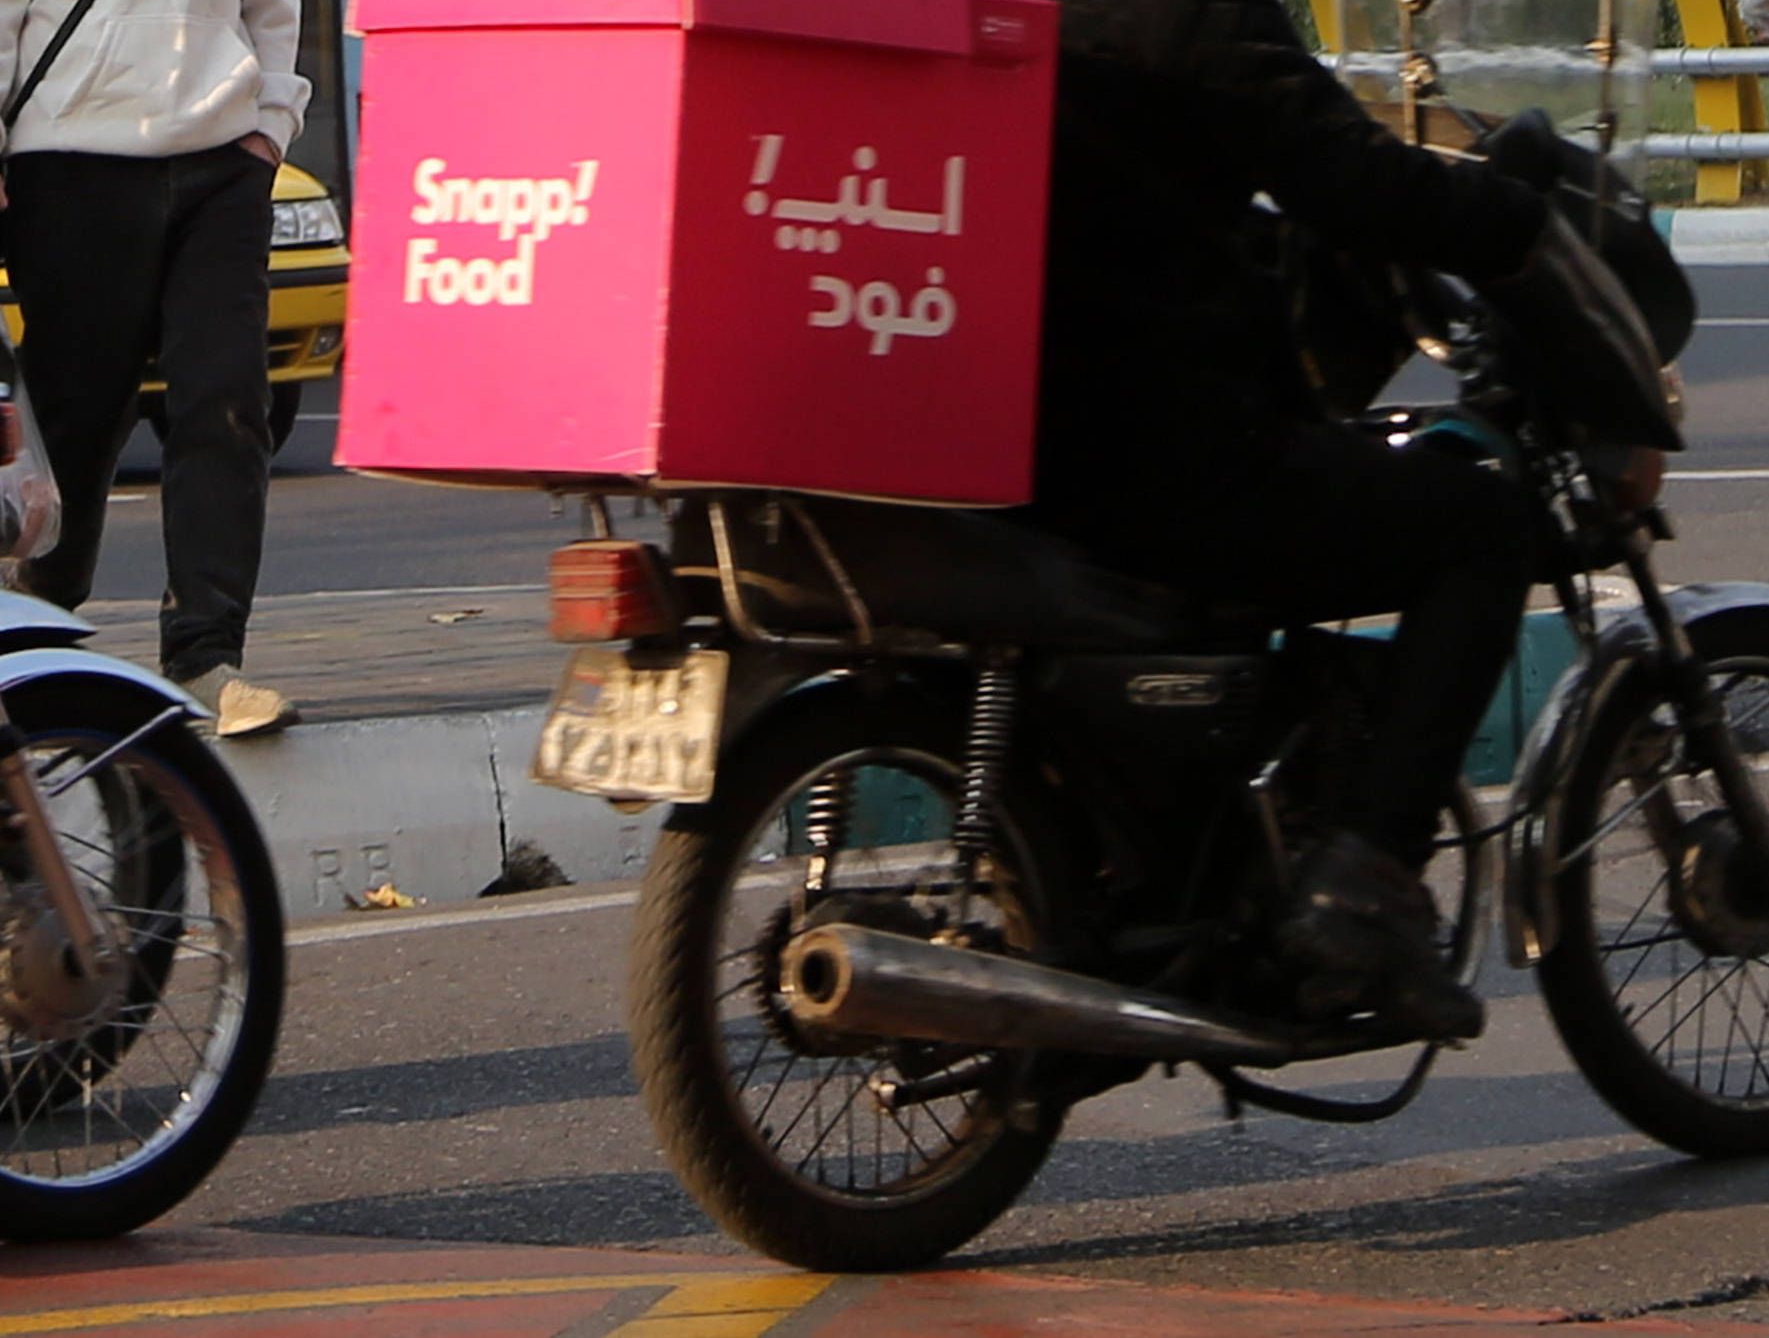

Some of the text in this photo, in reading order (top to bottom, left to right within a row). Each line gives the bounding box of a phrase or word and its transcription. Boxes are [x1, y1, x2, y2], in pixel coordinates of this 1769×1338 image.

[412, 159, 600, 242] Snapp!
[744, 133, 966, 254] اسنپ!
[404, 236, 534, 307] Food
[807, 267, 957, 356] فود
